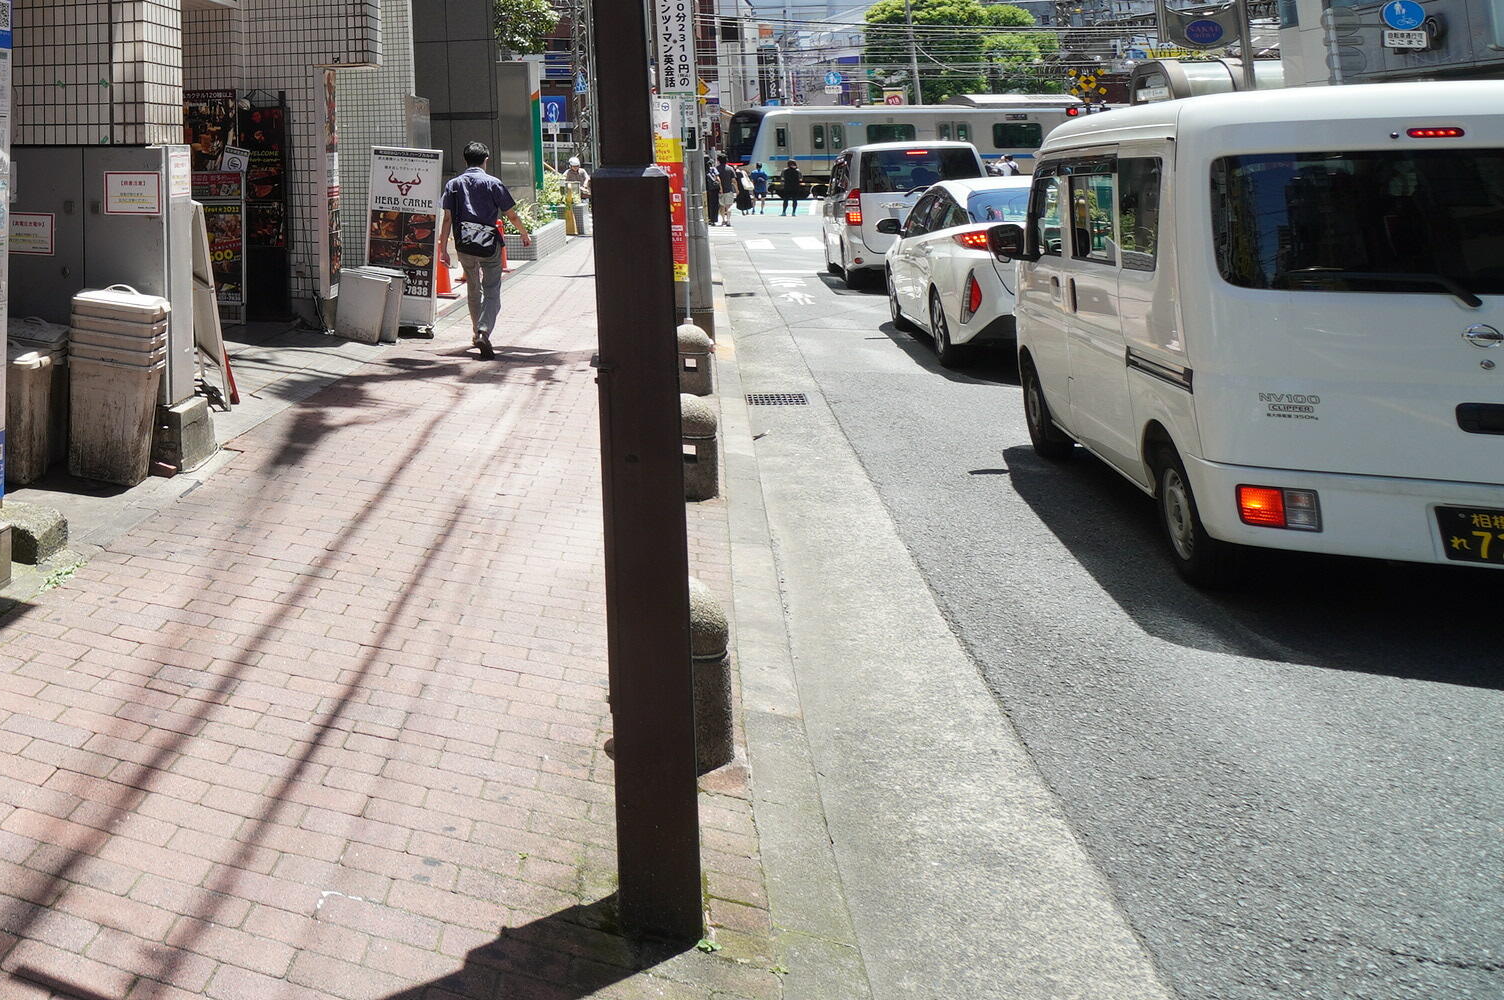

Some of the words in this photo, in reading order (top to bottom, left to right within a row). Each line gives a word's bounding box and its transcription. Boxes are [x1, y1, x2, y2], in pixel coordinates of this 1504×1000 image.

[375, 195, 401, 206] HERB
[403, 198, 433, 209] CARNE
[1258, 392, 1321, 405] NV100
[1271, 404, 1311, 413] CLIPPER
[1450, 536, 1472, 550] れ
